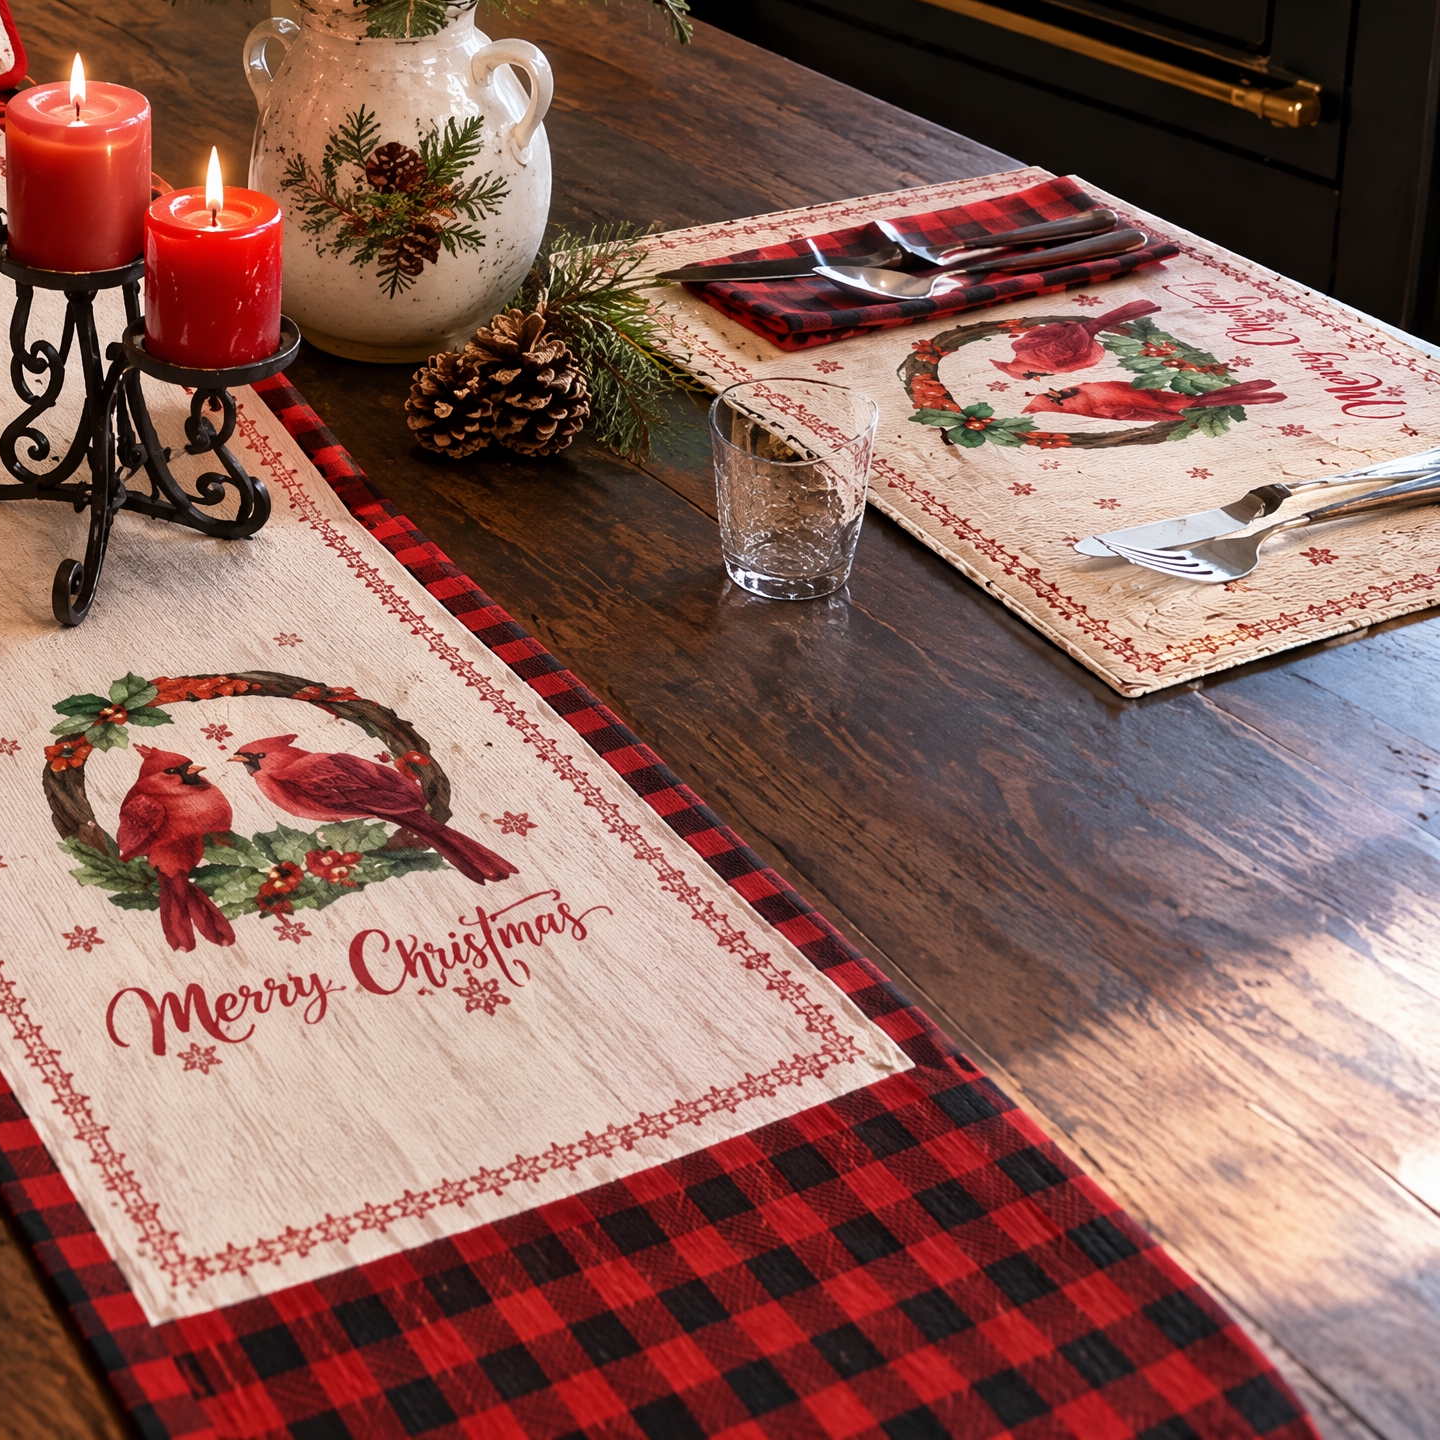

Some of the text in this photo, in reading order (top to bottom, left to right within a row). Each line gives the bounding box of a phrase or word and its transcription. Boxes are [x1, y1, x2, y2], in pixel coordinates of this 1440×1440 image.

[1291, 348, 1408, 419] Merry
[105, 889, 614, 1057] Merry Christmas
